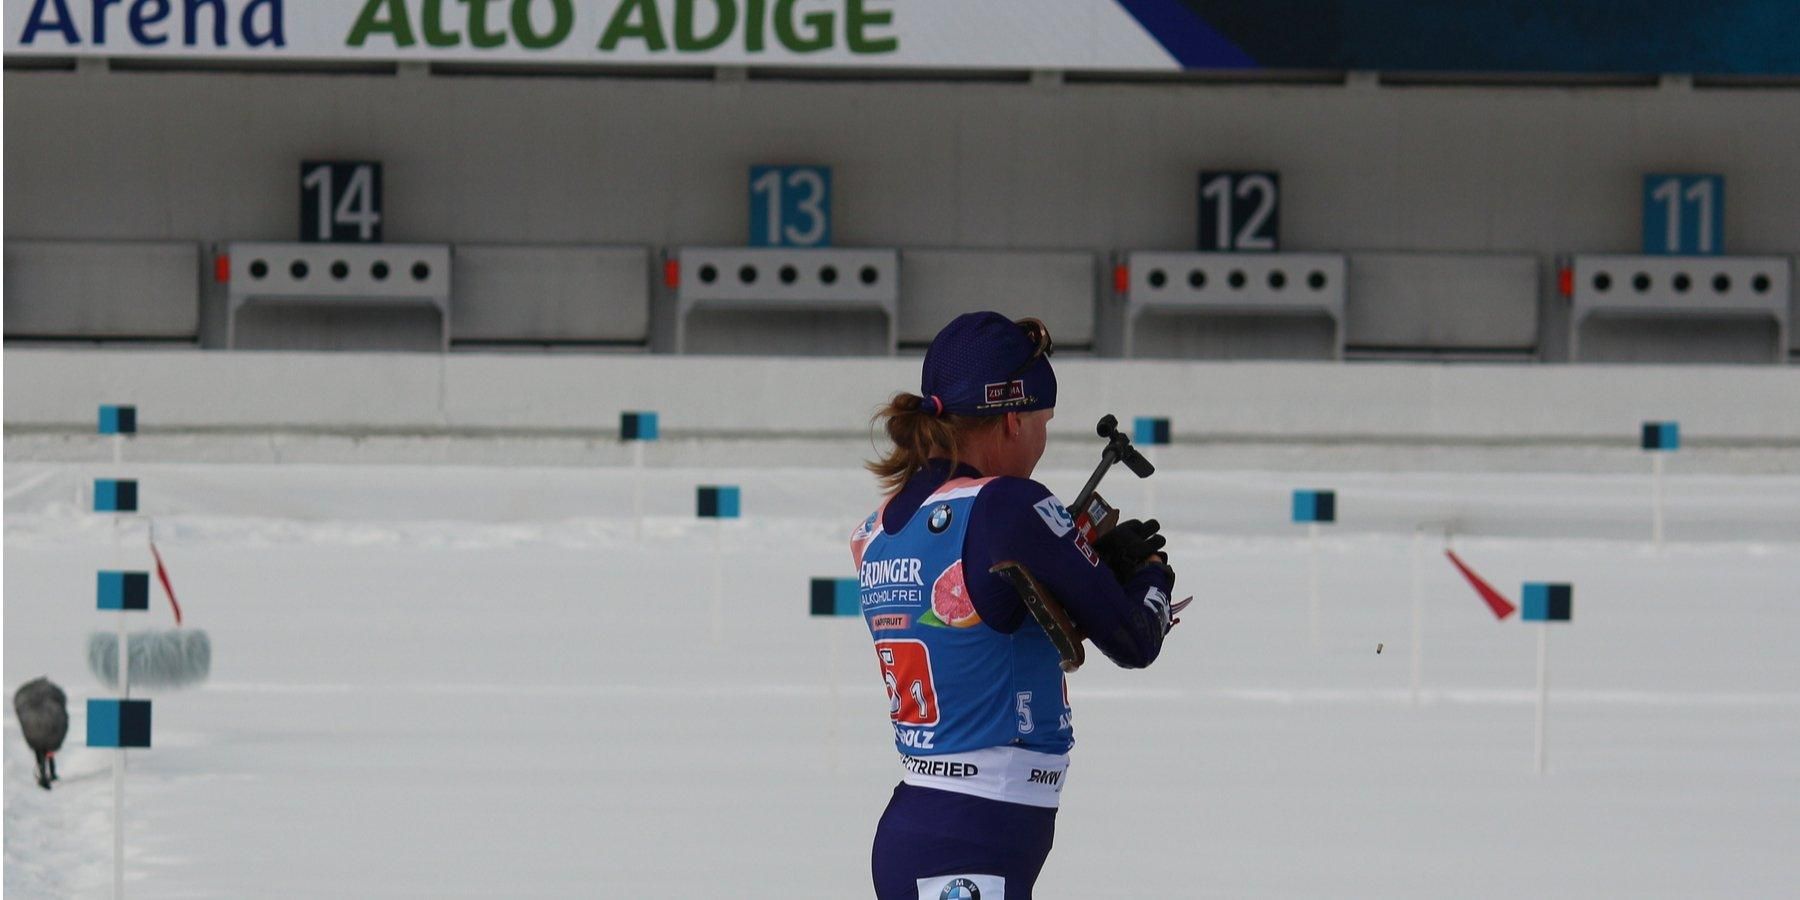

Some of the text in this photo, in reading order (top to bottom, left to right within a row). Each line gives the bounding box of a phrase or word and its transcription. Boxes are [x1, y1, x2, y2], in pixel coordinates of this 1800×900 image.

[18, 0, 286, 48] Arena
[596, 0, 899, 54] ADIGE
[303, 165, 380, 240] 14
[753, 169, 826, 246] 13
[1202, 174, 1276, 249] 12
[1652, 180, 1713, 252] 11
[860, 558, 924, 588] ERDINGER
[861, 589, 922, 605] ALKOHOLFREI
[910, 679, 928, 718] 1
[1015, 691, 1035, 734] 5
[1027, 768, 1062, 786] BMW
[943, 879, 977, 893] BMW
